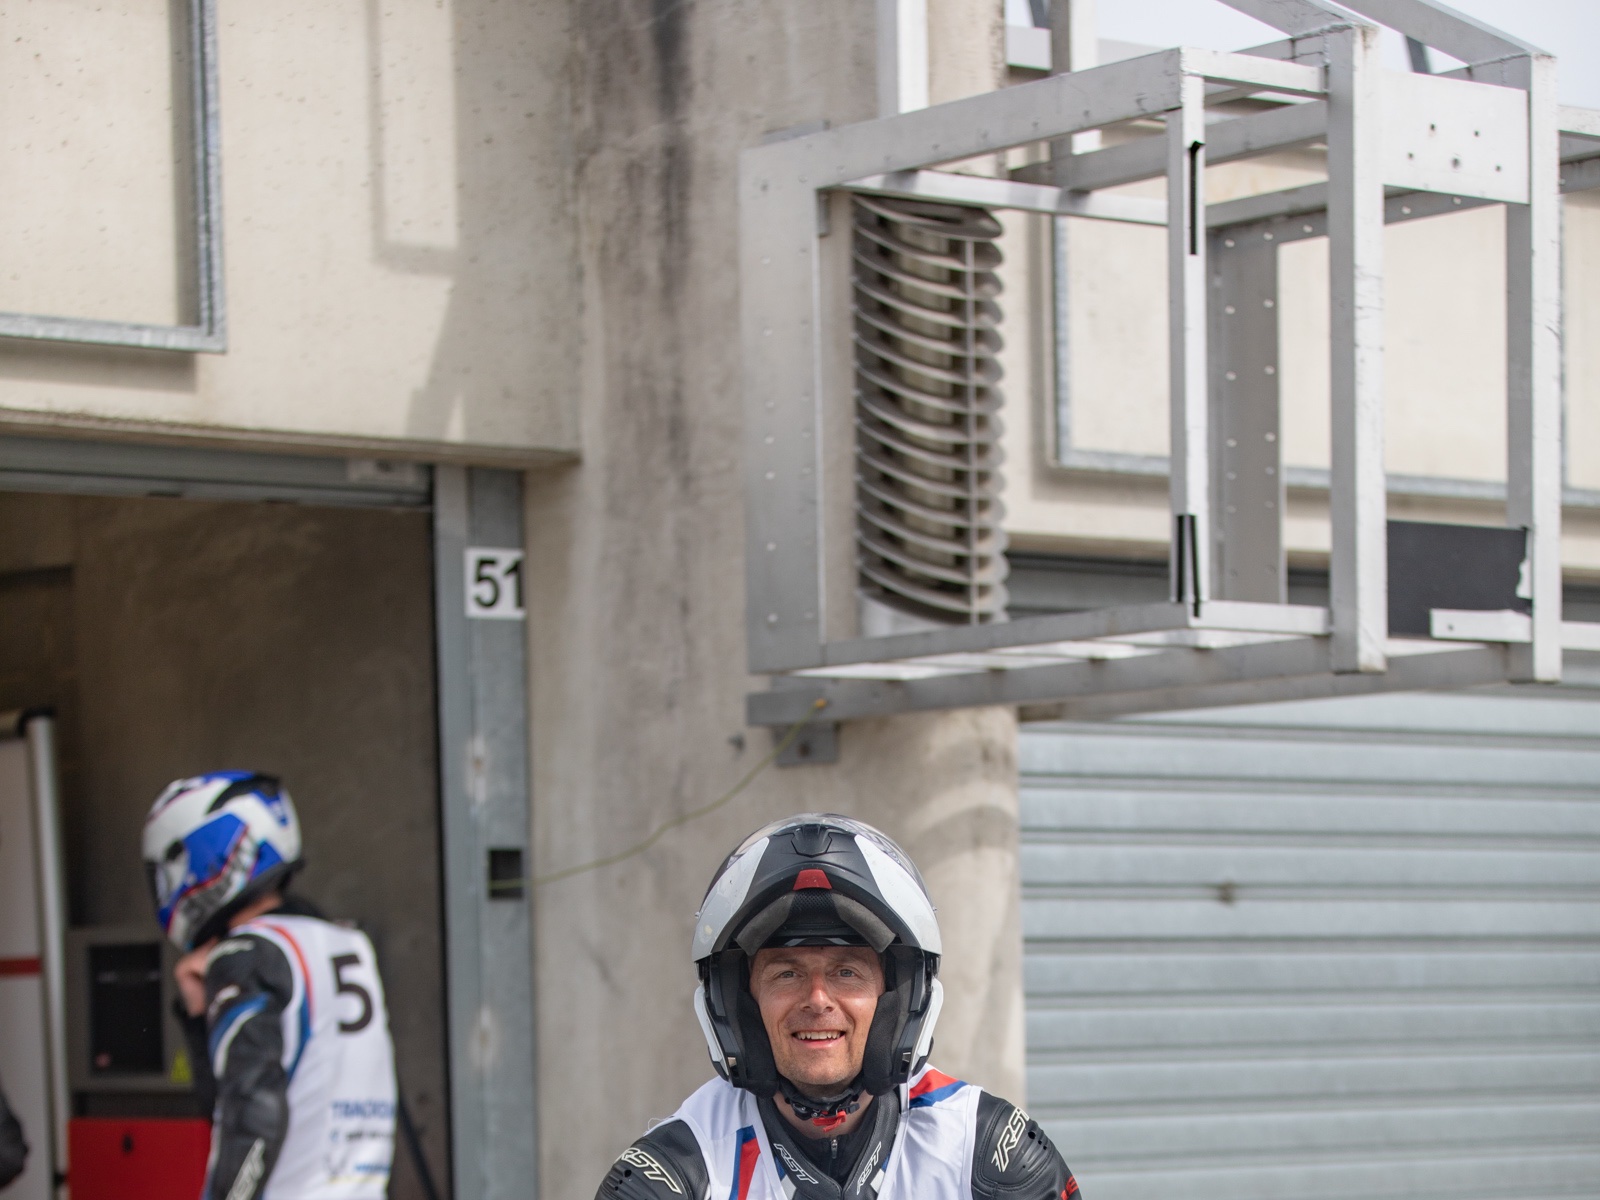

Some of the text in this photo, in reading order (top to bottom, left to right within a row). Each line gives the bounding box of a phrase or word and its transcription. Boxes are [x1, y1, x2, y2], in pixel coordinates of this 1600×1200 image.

[474, 558, 523, 609] 51
[330, 954, 374, 1036] 5
[615, 1147, 682, 1194] RST
[773, 1142, 819, 1185] RST
[856, 1140, 882, 1196] RST
